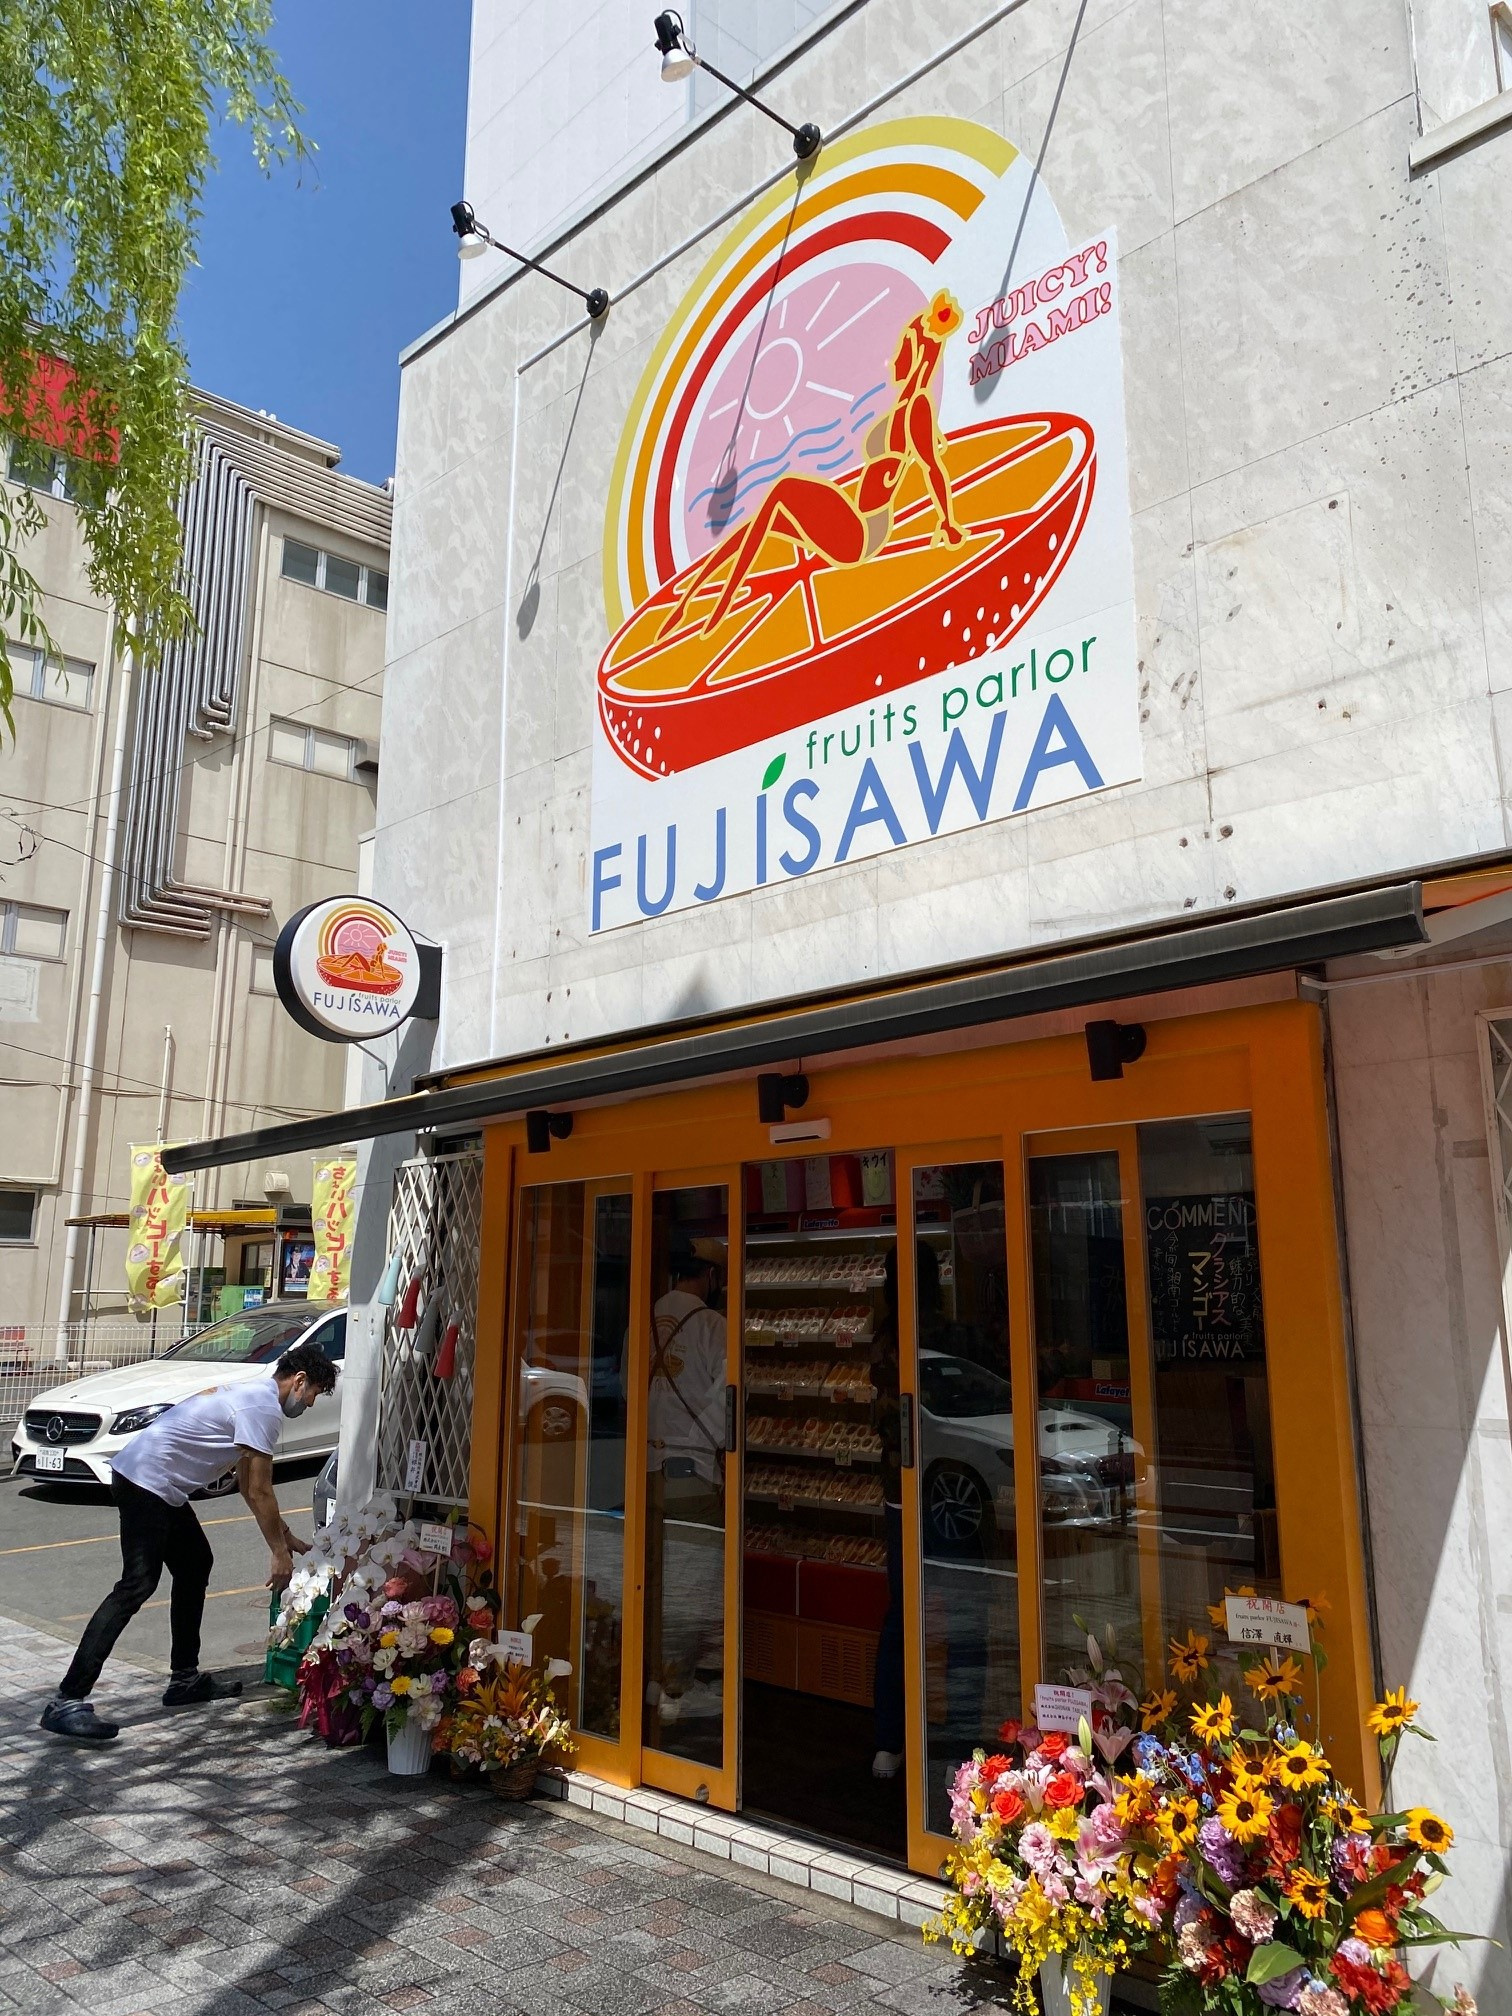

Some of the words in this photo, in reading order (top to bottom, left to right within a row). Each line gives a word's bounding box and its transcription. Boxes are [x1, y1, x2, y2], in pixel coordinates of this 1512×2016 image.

[966, 240, 1109, 345] JUICY!
[967, 282, 1113, 387] MIAMI!
[805, 701, 918, 770] fruits
[942, 636, 1098, 729] parlor
[591, 691, 1106, 931] FUJISAWA
[313, 991, 401, 1019] FUJISAWA
[358, 992, 378, 1001] fruits
[380, 996, 402, 1005] parlor
[862, 1151, 887, 1168] キウイ
[1187, 1250, 1214, 1331] マンゴー
